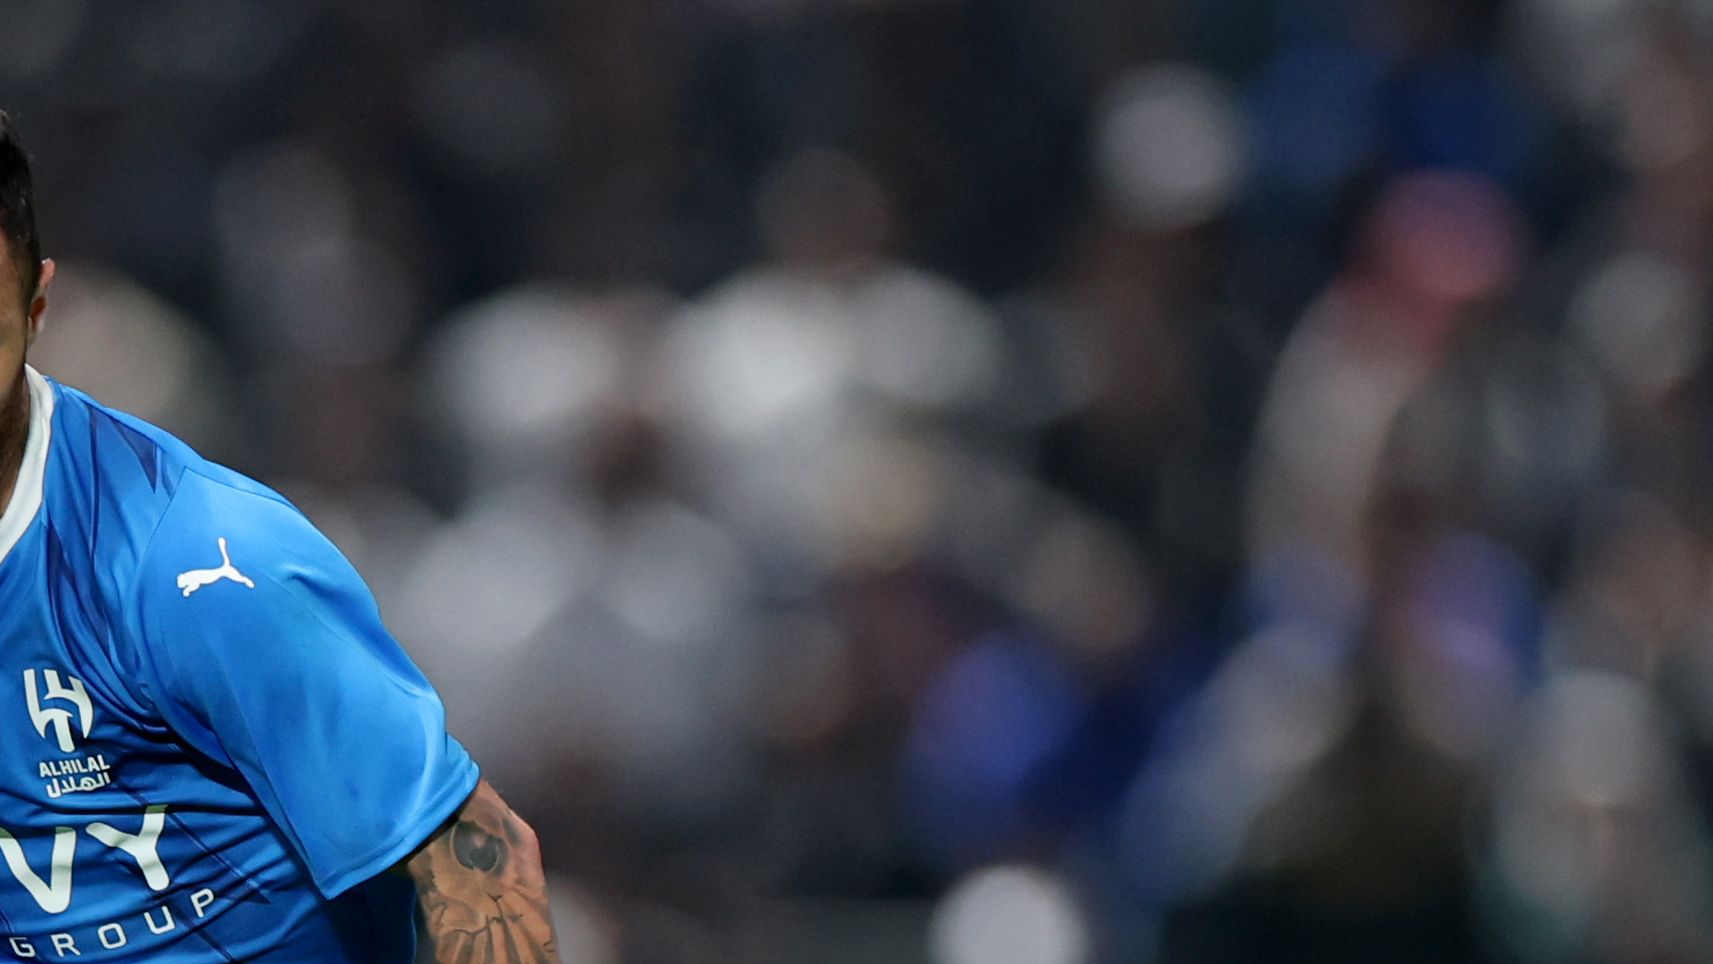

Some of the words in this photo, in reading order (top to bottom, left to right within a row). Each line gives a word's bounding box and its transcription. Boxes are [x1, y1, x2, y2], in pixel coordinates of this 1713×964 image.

[38, 754, 111, 778] ALHILAL
[45, 771, 111, 799] الهلال
[9, 888, 215, 958] GROUP
